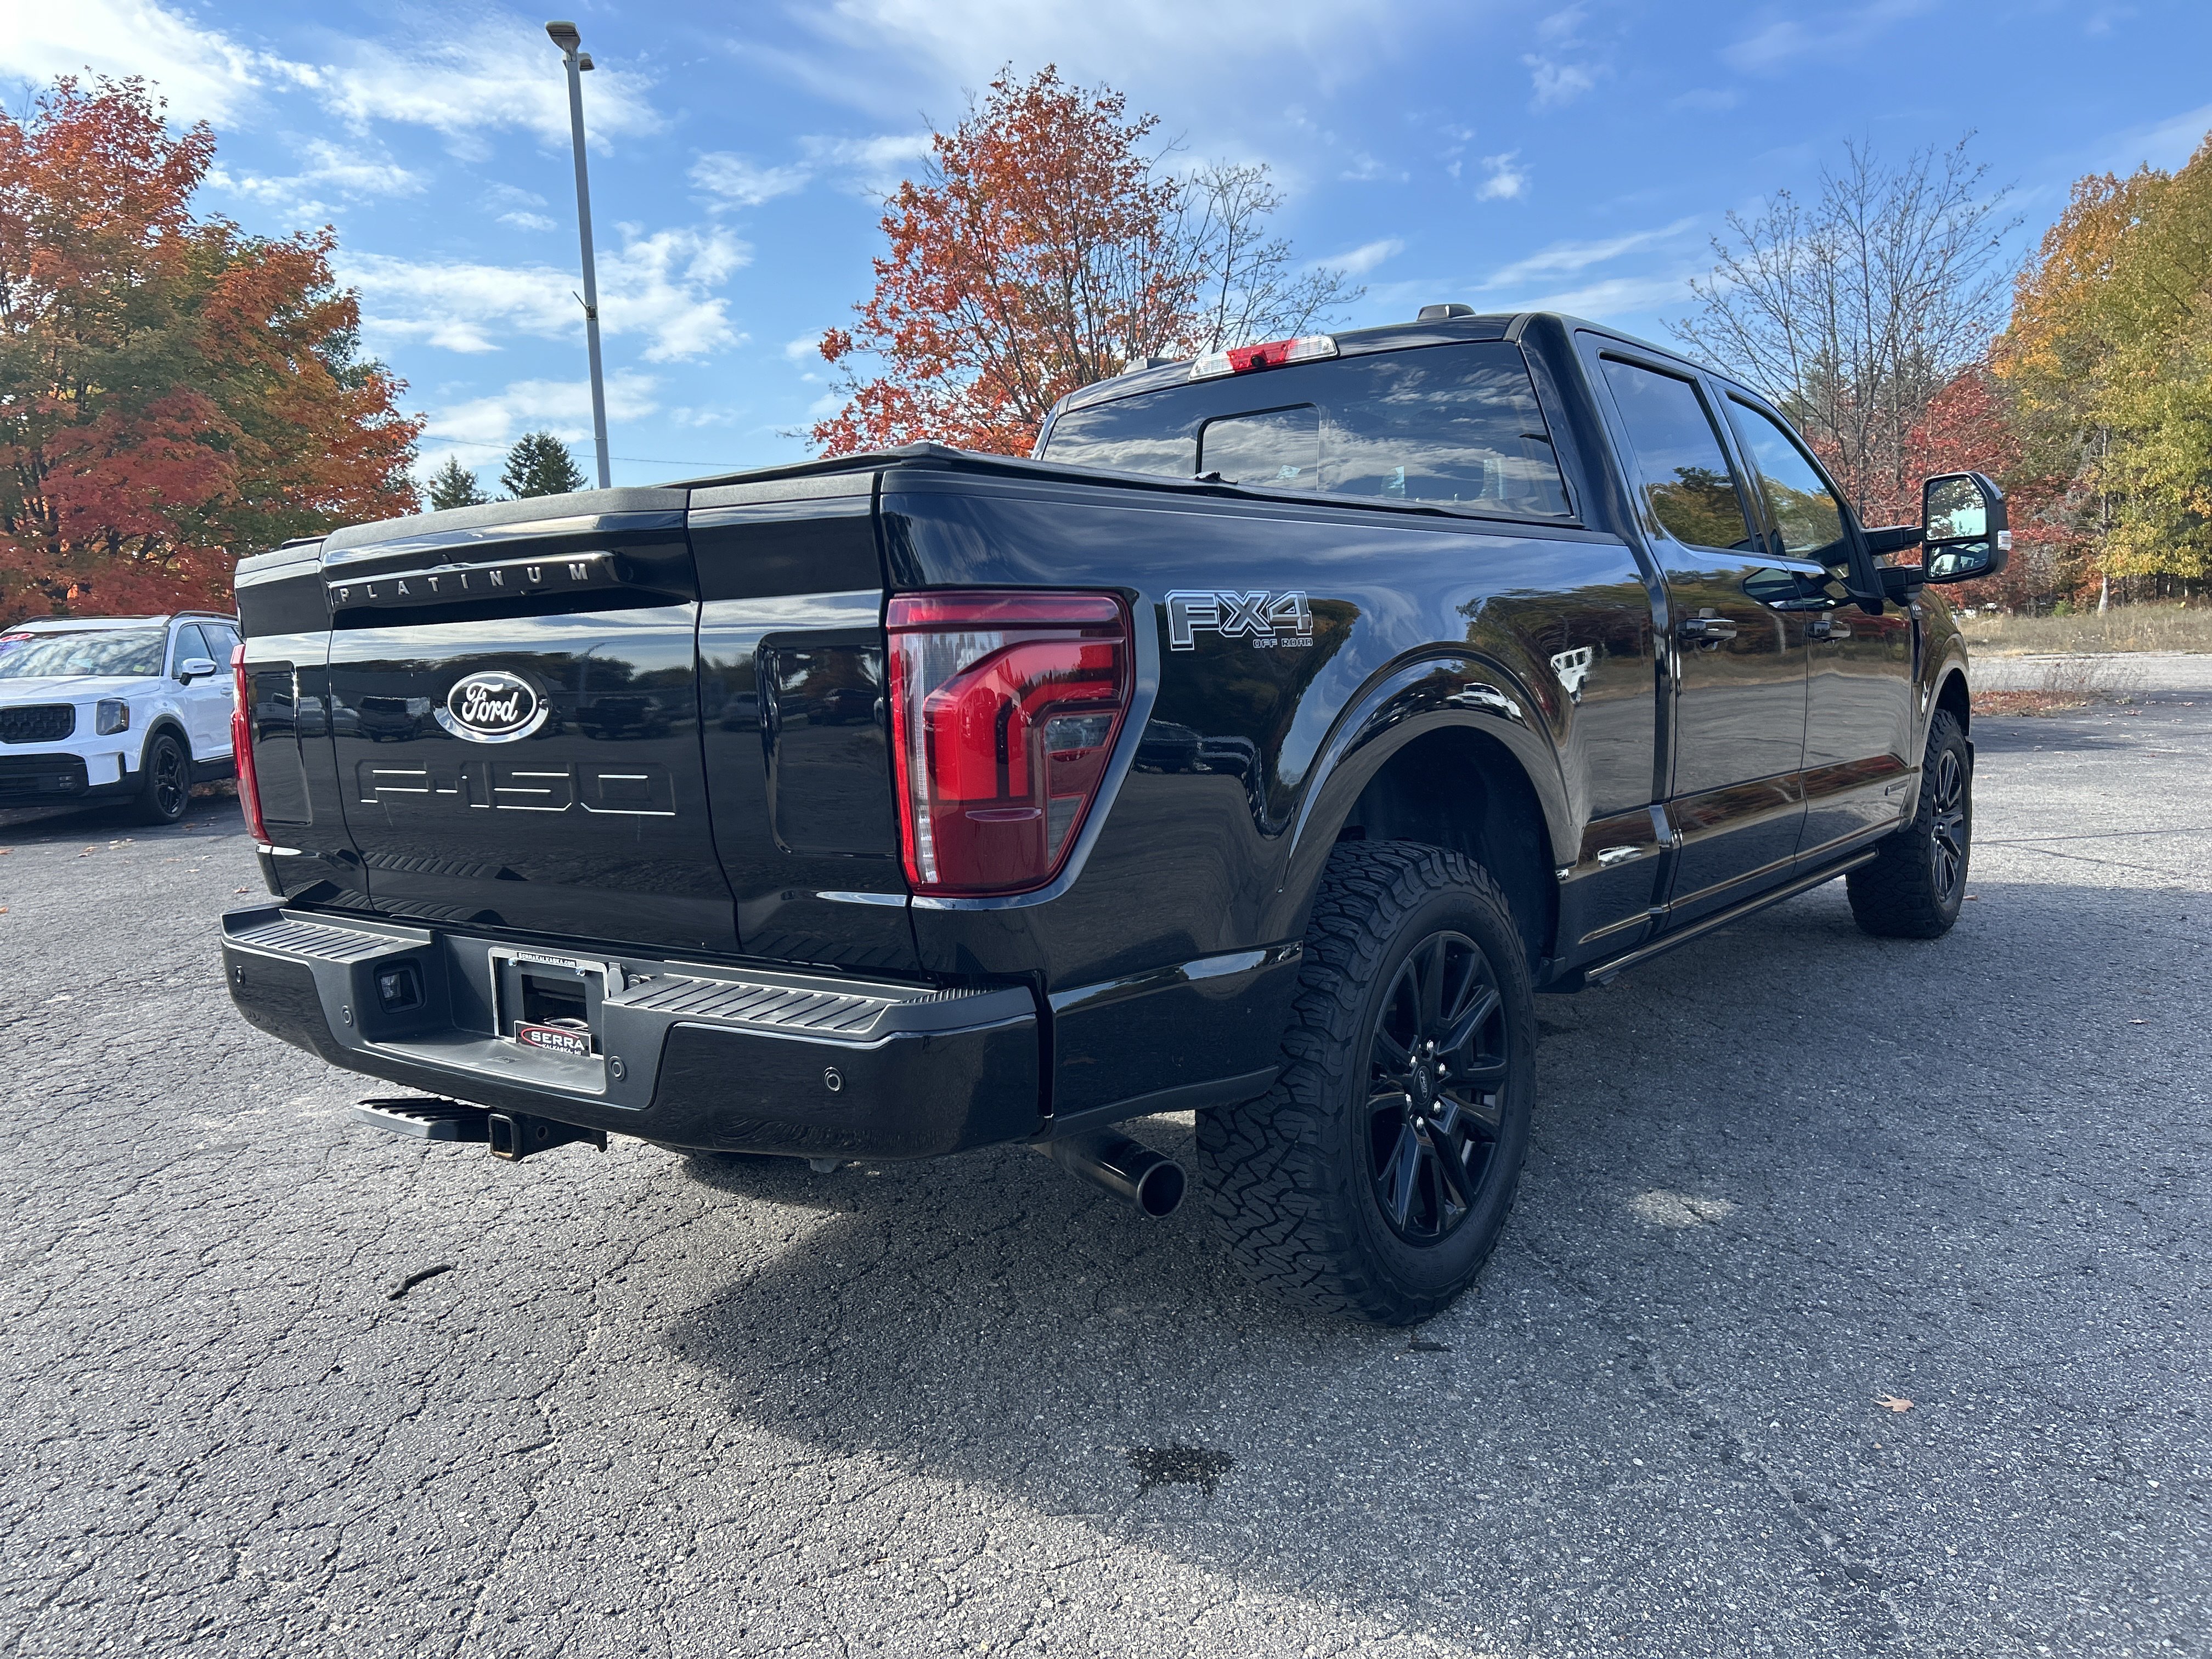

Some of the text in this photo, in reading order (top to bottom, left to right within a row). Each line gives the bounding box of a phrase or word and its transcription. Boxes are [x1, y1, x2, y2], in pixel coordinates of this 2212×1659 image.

[339, 563, 589, 602] PLATINUM
[1165, 589, 1313, 651] FX4
[1253, 637, 1313, 648] OFF ROAD
[462, 682, 518, 721] Ford
[355, 759, 676, 816] F-150
[531, 1031, 585, 1050] SERRA
